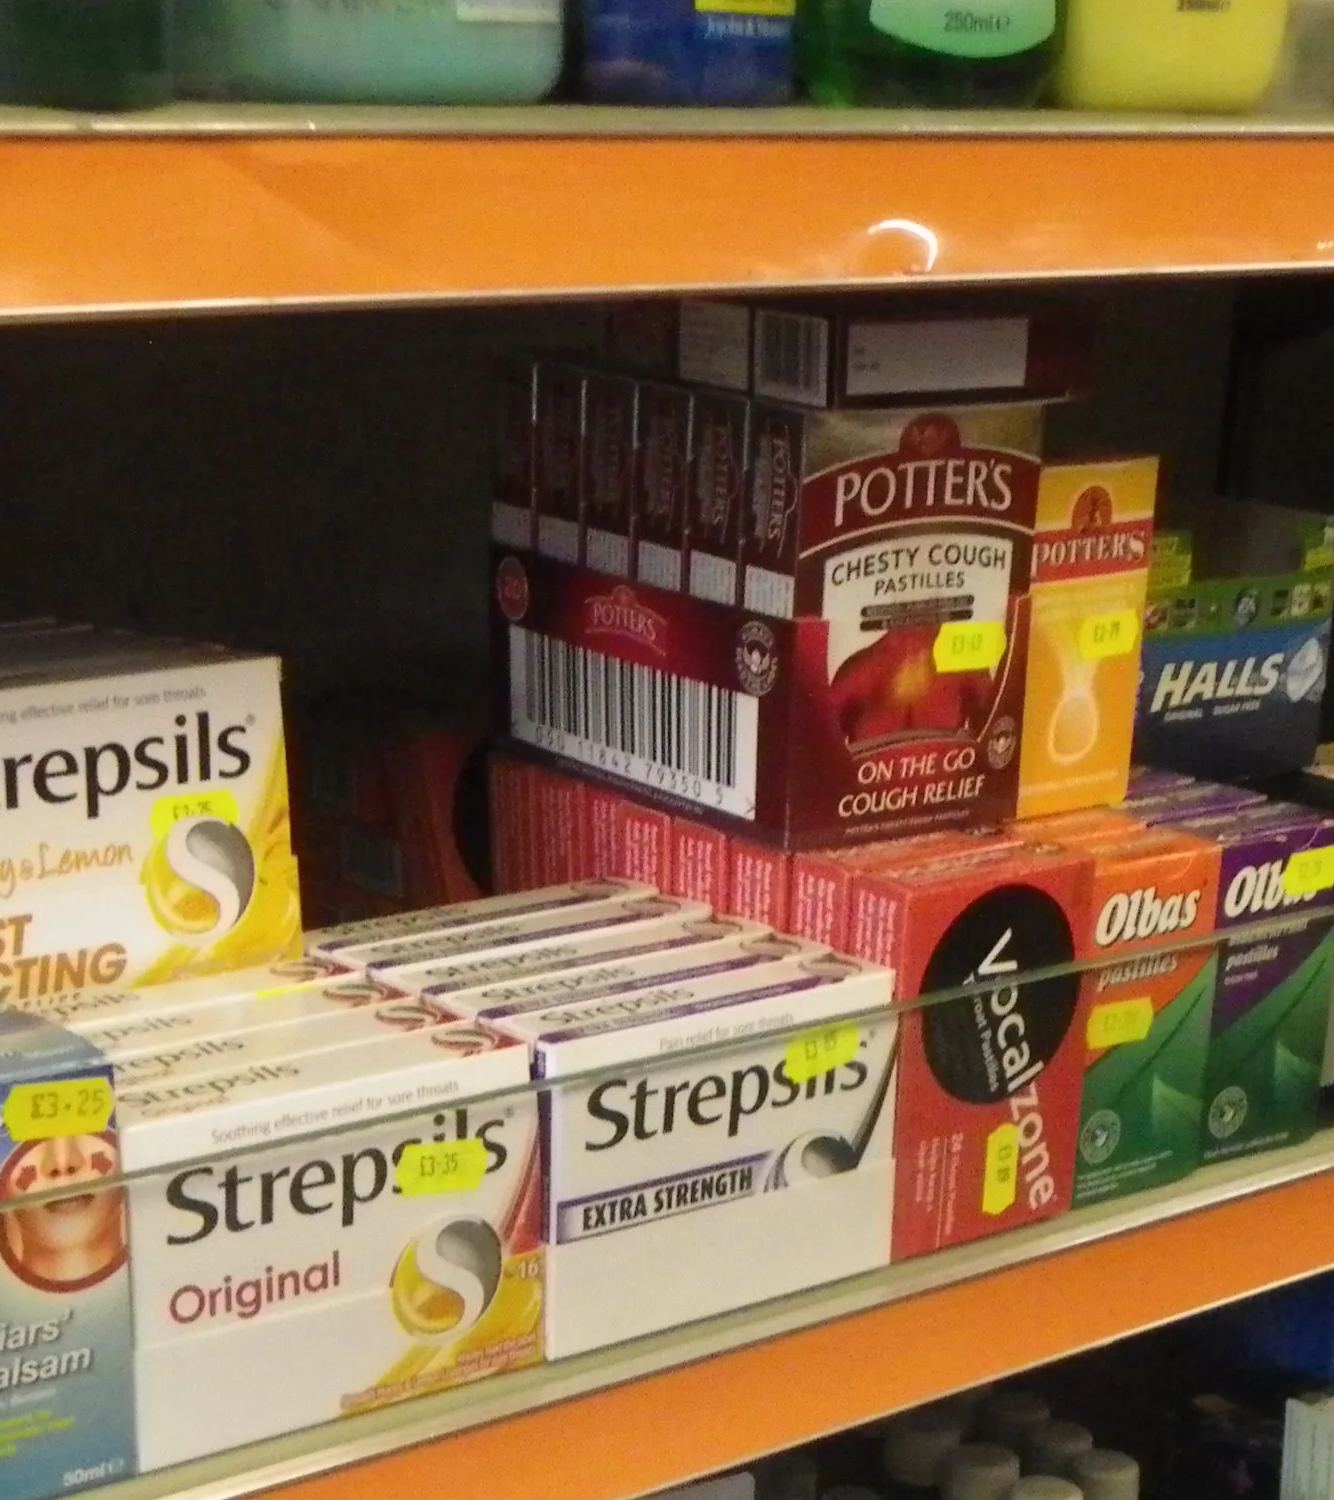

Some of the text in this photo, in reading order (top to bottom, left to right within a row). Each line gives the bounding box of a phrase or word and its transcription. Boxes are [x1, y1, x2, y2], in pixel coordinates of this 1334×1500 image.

[831, 458, 1013, 527] POTTER'S
[829, 538, 1008, 588] CHESTY COUGH
[873, 569, 966, 595] PASTILLES
[21, 700, 78, 725] effective
[81, 696, 108, 714] relief
[110, 694, 128, 711] for
[131, 694, 161, 709] sore
[165, 684, 207, 704] throats
[1149, 652, 1286, 714] HALLS
[857, 746, 976, 786] ON THE GO
[837, 772, 986, 819] COUGH RELIEF
[38, 842, 135, 880] Lemon
[1094, 886, 1201, 947] Olbas
[1096, 952, 1179, 993] pastilles
[1224, 944, 1280, 971] pastilles
[685, 1030, 714, 1046] relief
[979, 1029, 1000, 1093] Pastilles
[978, 927, 1059, 1211] Vocalzone
[211, 1079, 460, 1145] Soothing effective relief for sore throats
[166, 1108, 511, 1247] Streps
[582, 1166, 754, 1232] EXTRA STRENGTH
[169, 1250, 342, 1325] Original
[516, 1256, 540, 1279] 16
